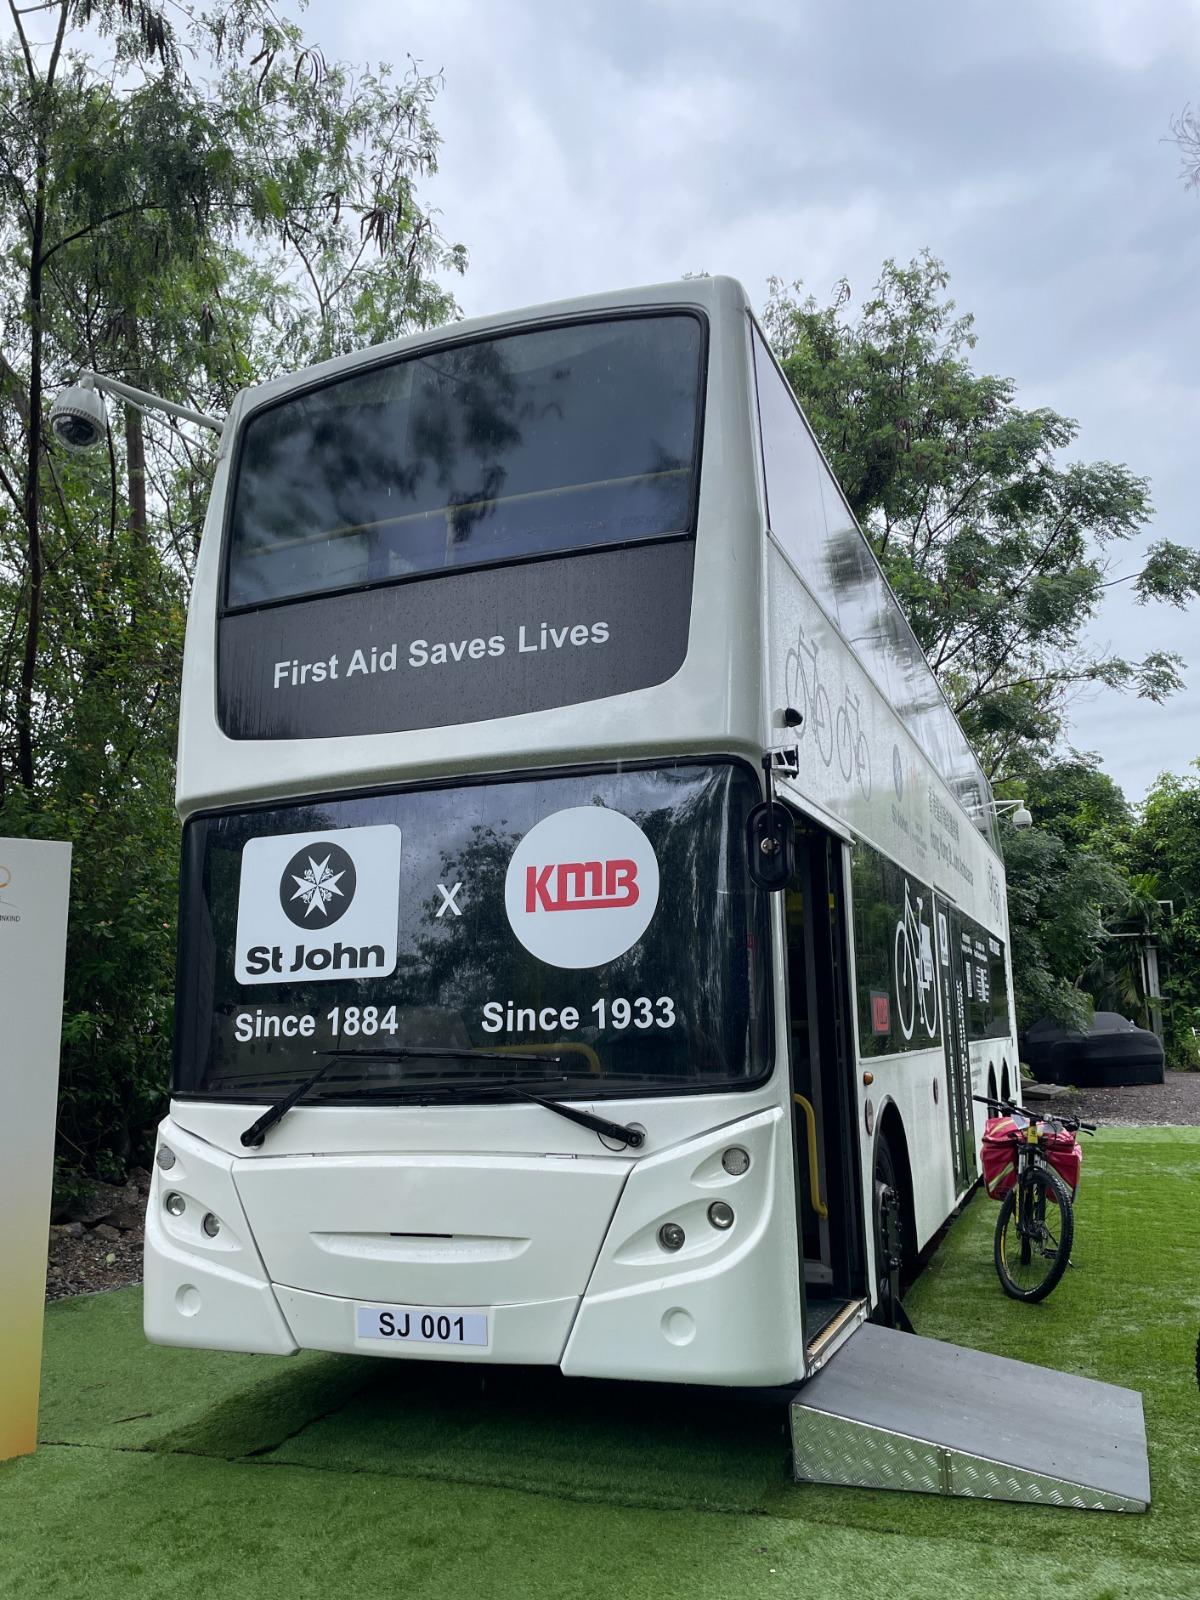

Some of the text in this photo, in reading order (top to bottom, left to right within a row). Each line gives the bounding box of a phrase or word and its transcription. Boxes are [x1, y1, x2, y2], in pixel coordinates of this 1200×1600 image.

[273, 621, 610, 689] First Aid Saves Lives
[525, 858, 641, 913] KMB
[245, 941, 385, 976] St John
[234, 1005, 399, 1042] Since 1884
[481, 996, 676, 1033] Since 1933
[378, 1312, 464, 1341] SJ 001
